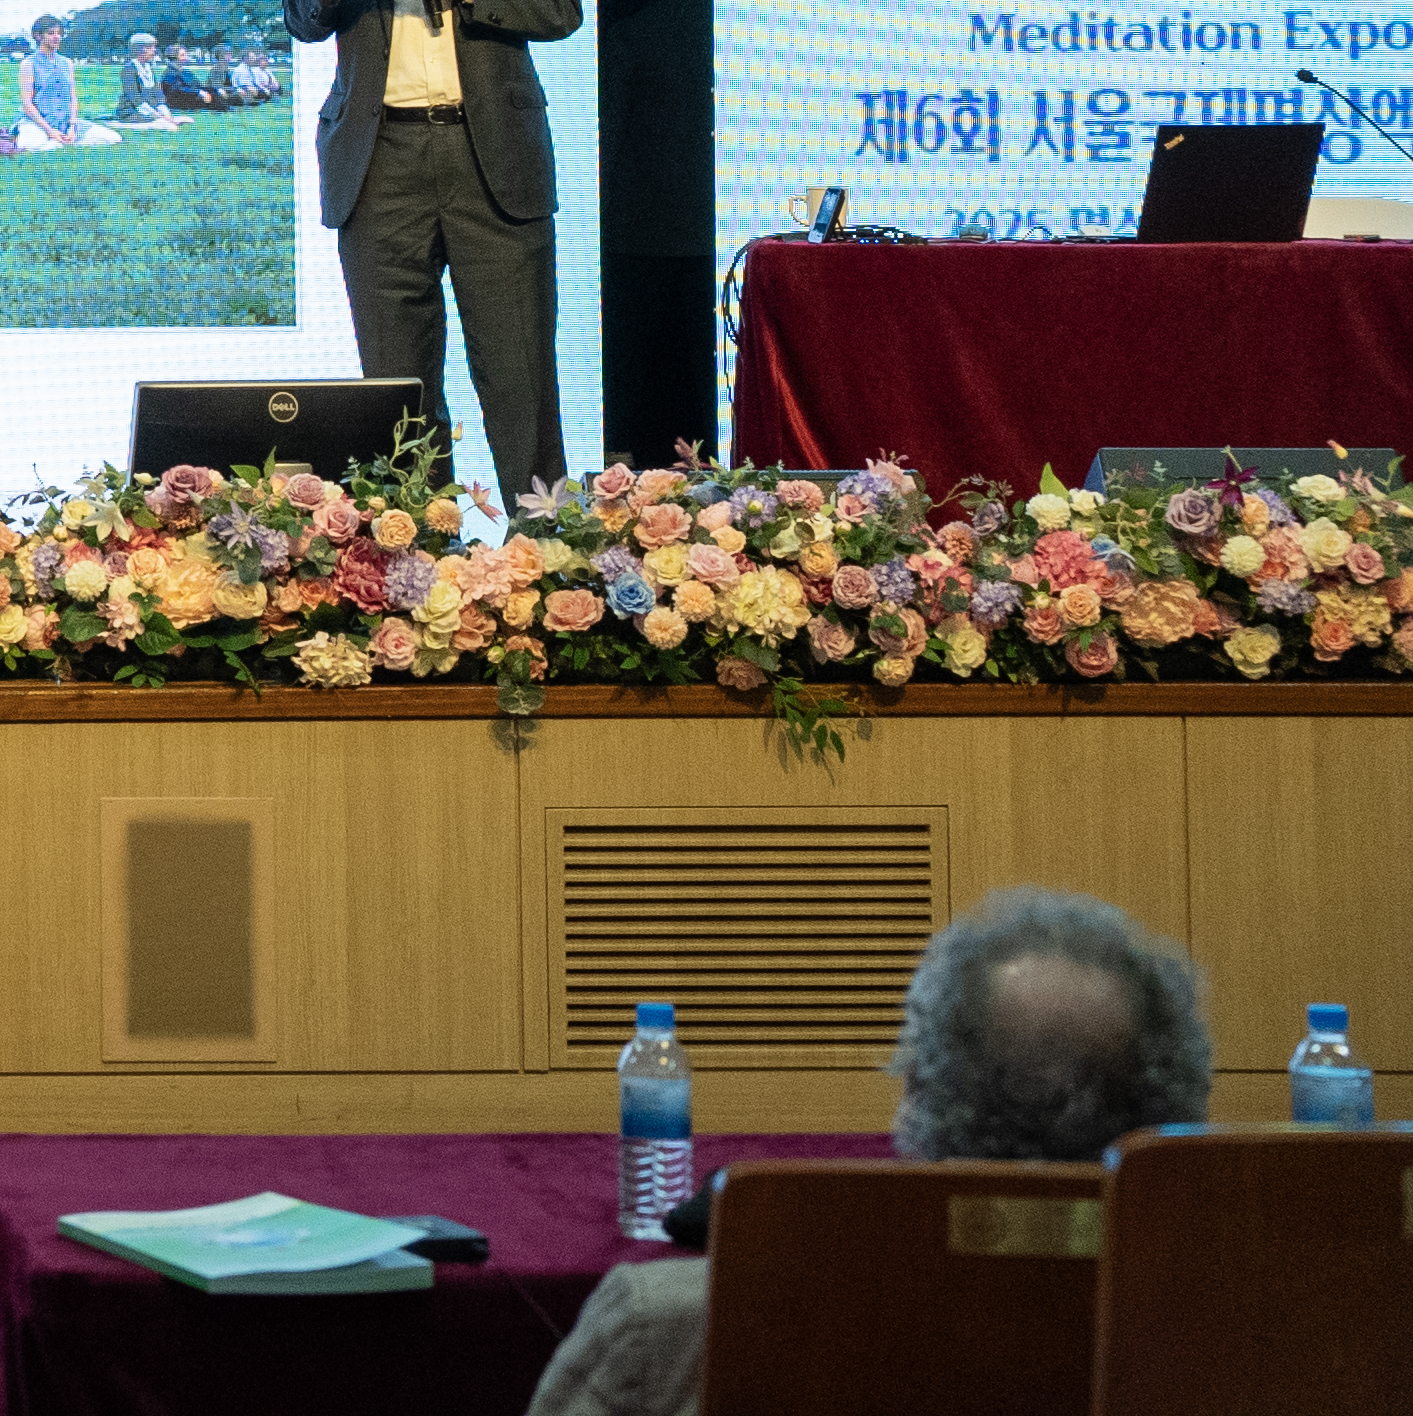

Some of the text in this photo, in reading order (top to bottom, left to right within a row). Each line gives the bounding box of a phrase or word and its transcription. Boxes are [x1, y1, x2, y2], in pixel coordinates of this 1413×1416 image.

[968, 10, 1413, 60] Meditation Expo
[855, 87, 1002, 164] 제6회
[271, 402, 295, 412] DELL
